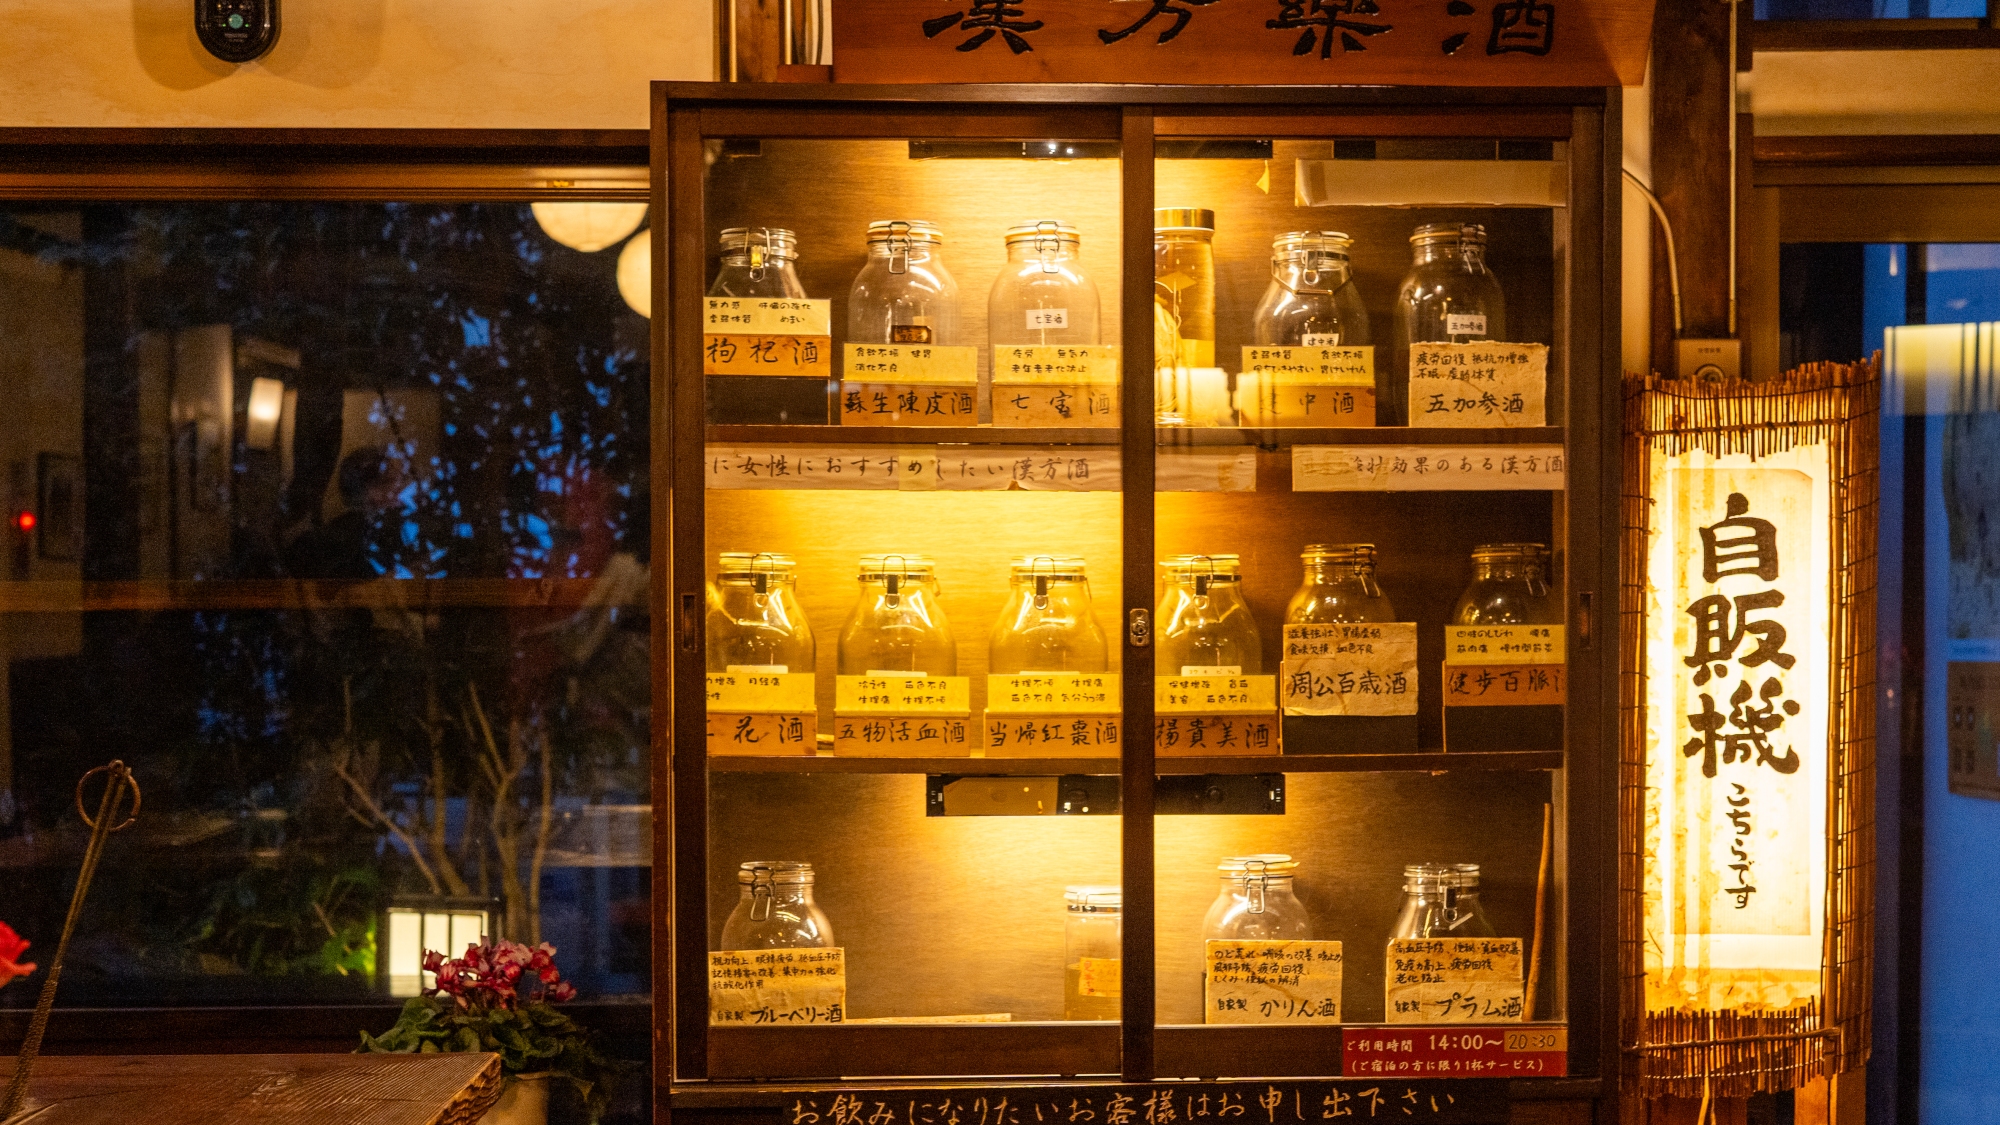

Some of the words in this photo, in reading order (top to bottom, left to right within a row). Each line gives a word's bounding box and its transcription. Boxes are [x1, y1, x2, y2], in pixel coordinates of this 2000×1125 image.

[780, 315, 806, 324] めまい
[706, 337, 819, 366] 枸杞酒
[855, 346, 899, 358] 食欲不振
[1416, 351, 1468, 366] 疲労回復
[855, 363, 898, 373] 消化不良
[844, 389, 973, 416] 蘇生陳皮酒
[1425, 391, 1524, 416] 五加参酒
[705, 453, 1091, 479] に女性におすすめしたい漢方酒
[1682, 491, 1801, 779] 自販機
[1289, 670, 1407, 700] 周公百歳酒
[837, 719, 966, 745] 五物活血酒
[1725, 782, 1757, 910] こちらです
[750, 1003, 843, 1024] ブルーベリー酒
[1260, 998, 1336, 1018] かりん酒
[1435, 992, 1522, 1019] プラム酒
[1346, 1038, 1413, 1053] ご利用時間
[792, 1085, 1456, 1125] お飲みになりたいお客様はお申し出下さい
